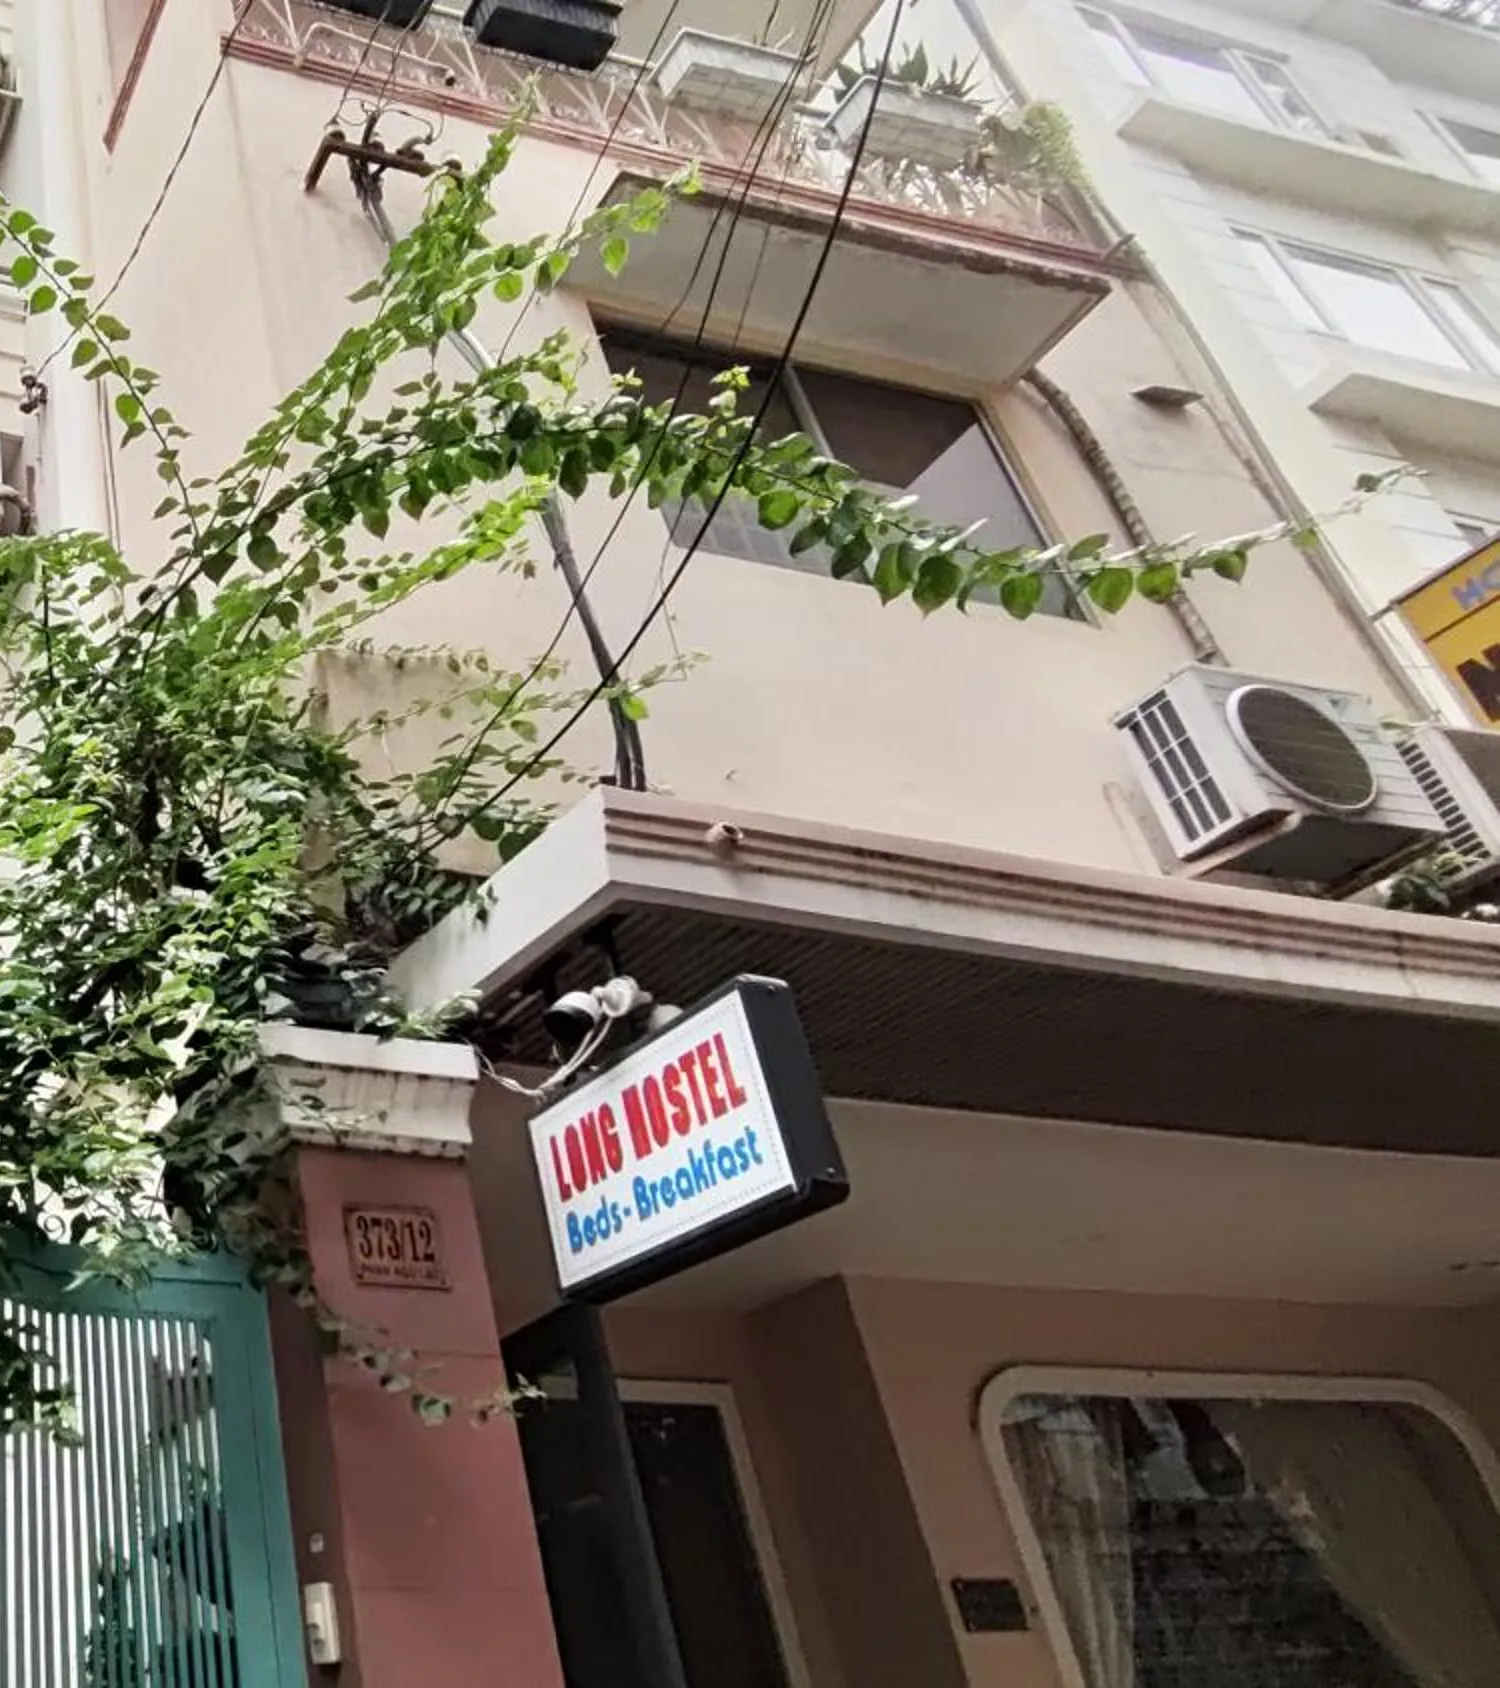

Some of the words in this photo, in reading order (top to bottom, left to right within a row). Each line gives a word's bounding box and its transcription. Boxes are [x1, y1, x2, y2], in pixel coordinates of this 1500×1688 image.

[549, 1102, 624, 1203] LONG
[621, 1032, 748, 1160] HOSTEL
[355, 1215, 436, 1262] 373/12
